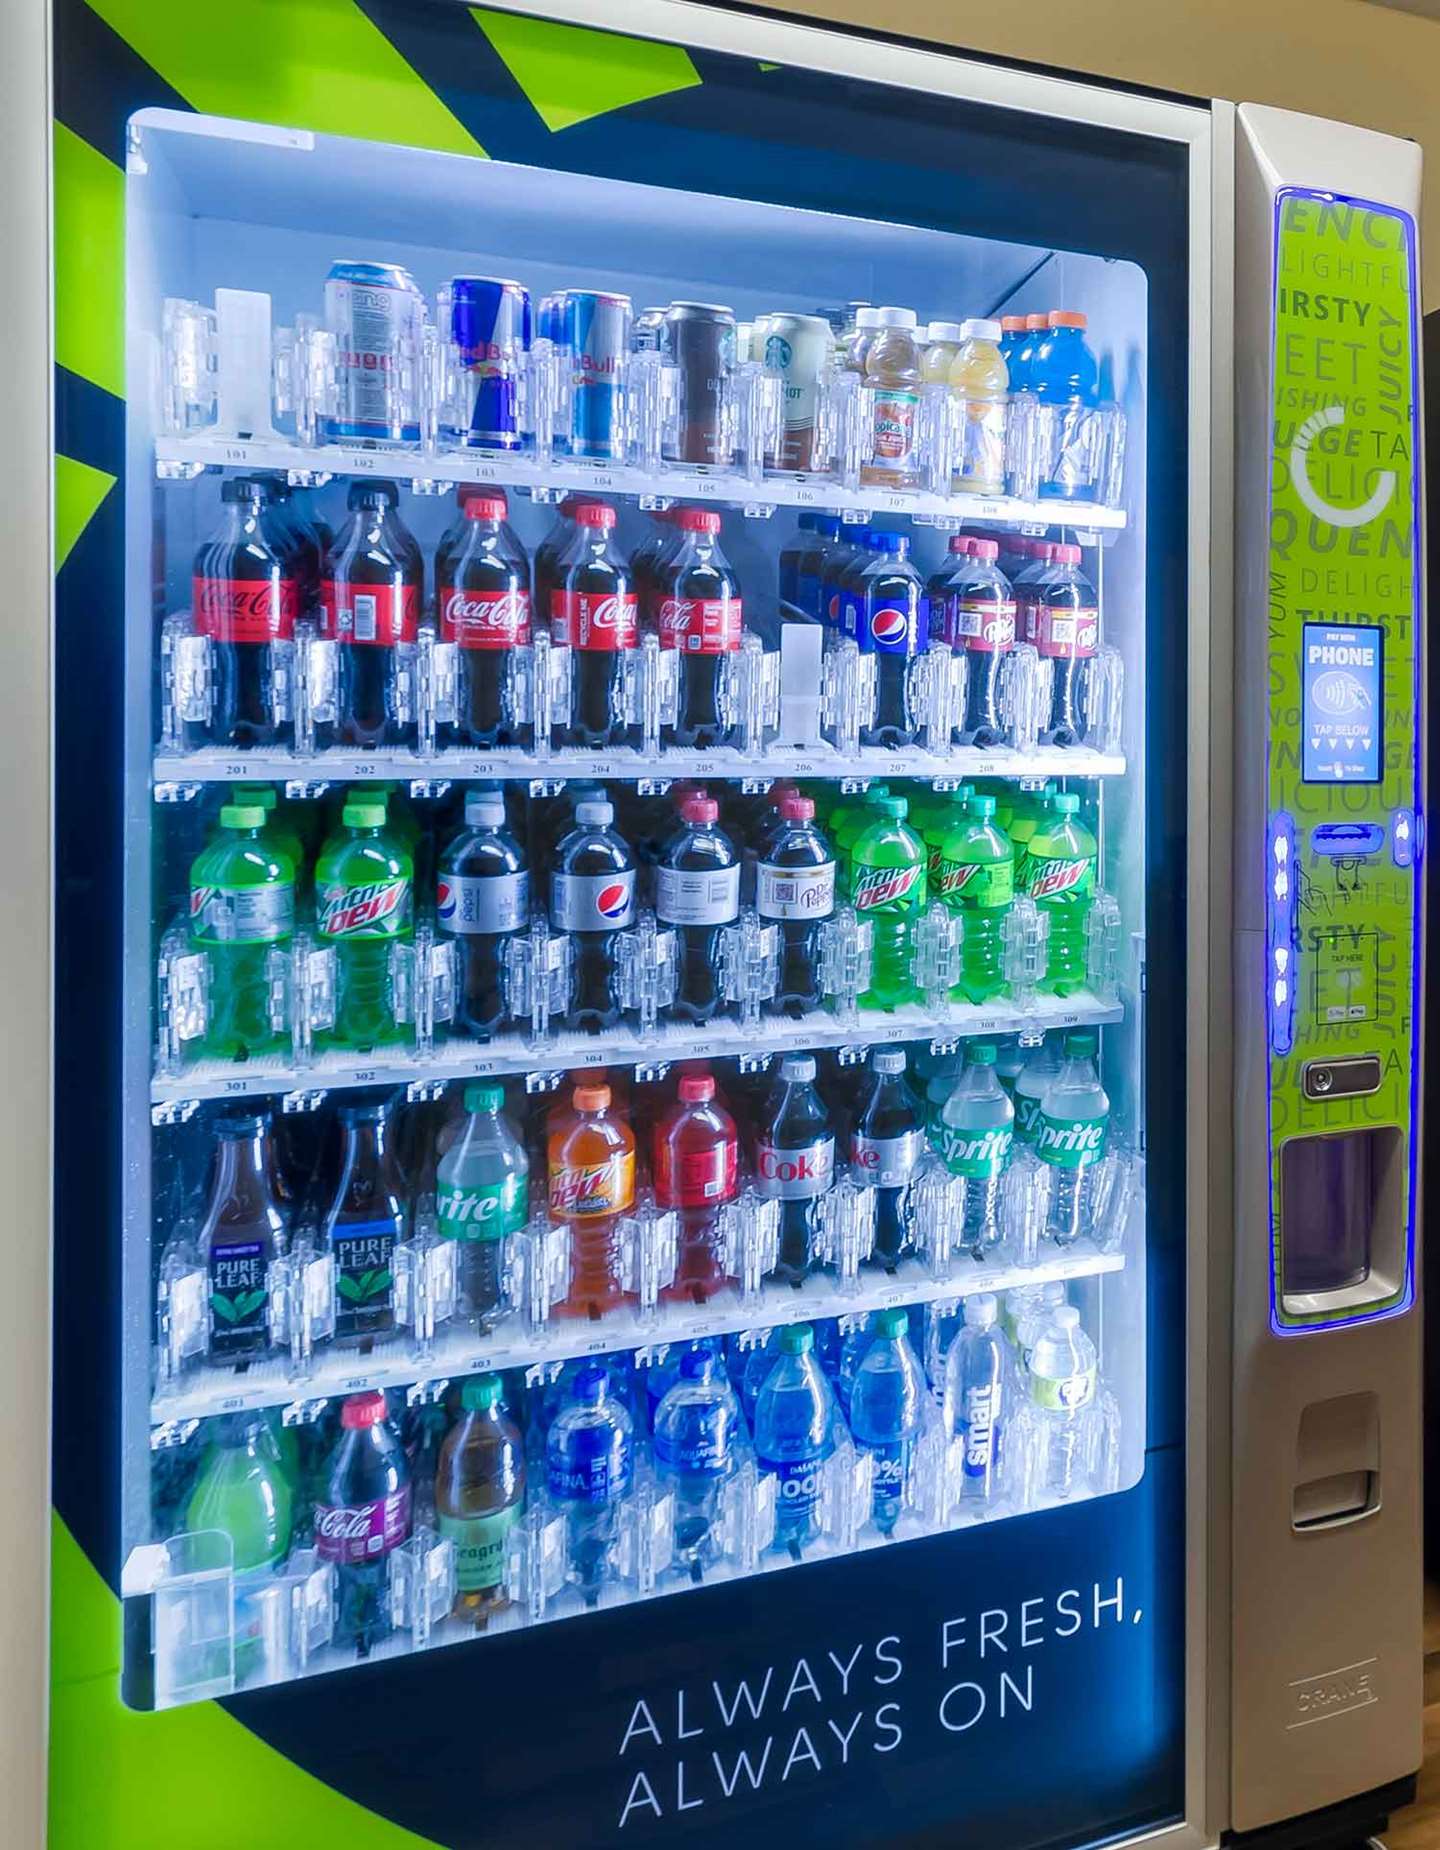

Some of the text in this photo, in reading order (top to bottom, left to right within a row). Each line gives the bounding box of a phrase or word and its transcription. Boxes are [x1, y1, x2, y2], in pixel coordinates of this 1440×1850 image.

[1378, 304, 1403, 425] JUICY
[225, 449, 247, 460] 101
[353, 458, 374, 469] 102
[475, 467, 496, 478] 103
[593, 476, 612, 486] 104
[698, 483, 715, 493] 105
[796, 491, 814, 501] 106
[446, 592, 530, 627] Coca-Cola
[1308, 644, 1375, 667] PHONE
[1335, 724, 1370, 737] BELOW
[226, 765, 248, 775] 201
[354, 765, 376, 775] 202
[472, 763, 494, 774] 203
[591, 763, 611, 774] 204
[695, 763, 714, 773] 205
[794, 763, 813, 773] 206
[889, 763, 907, 773] 207
[978, 764, 995, 773] 208
[354, 1071, 376, 1081] 302
[224, 1081, 247, 1092] 301
[941, 1126, 1013, 1162] Sprite
[339, 1236, 392, 1255] PURE
[338, 1249, 392, 1268] LEAF
[216, 1258, 260, 1275] PURE
[215, 1272, 260, 1289] LEAF
[965, 1383, 991, 1467] smart
[618, 1576, 1144, 1755] ALWAYS FRESH,
[618, 1665, 1034, 1828] ALWAYS ON
